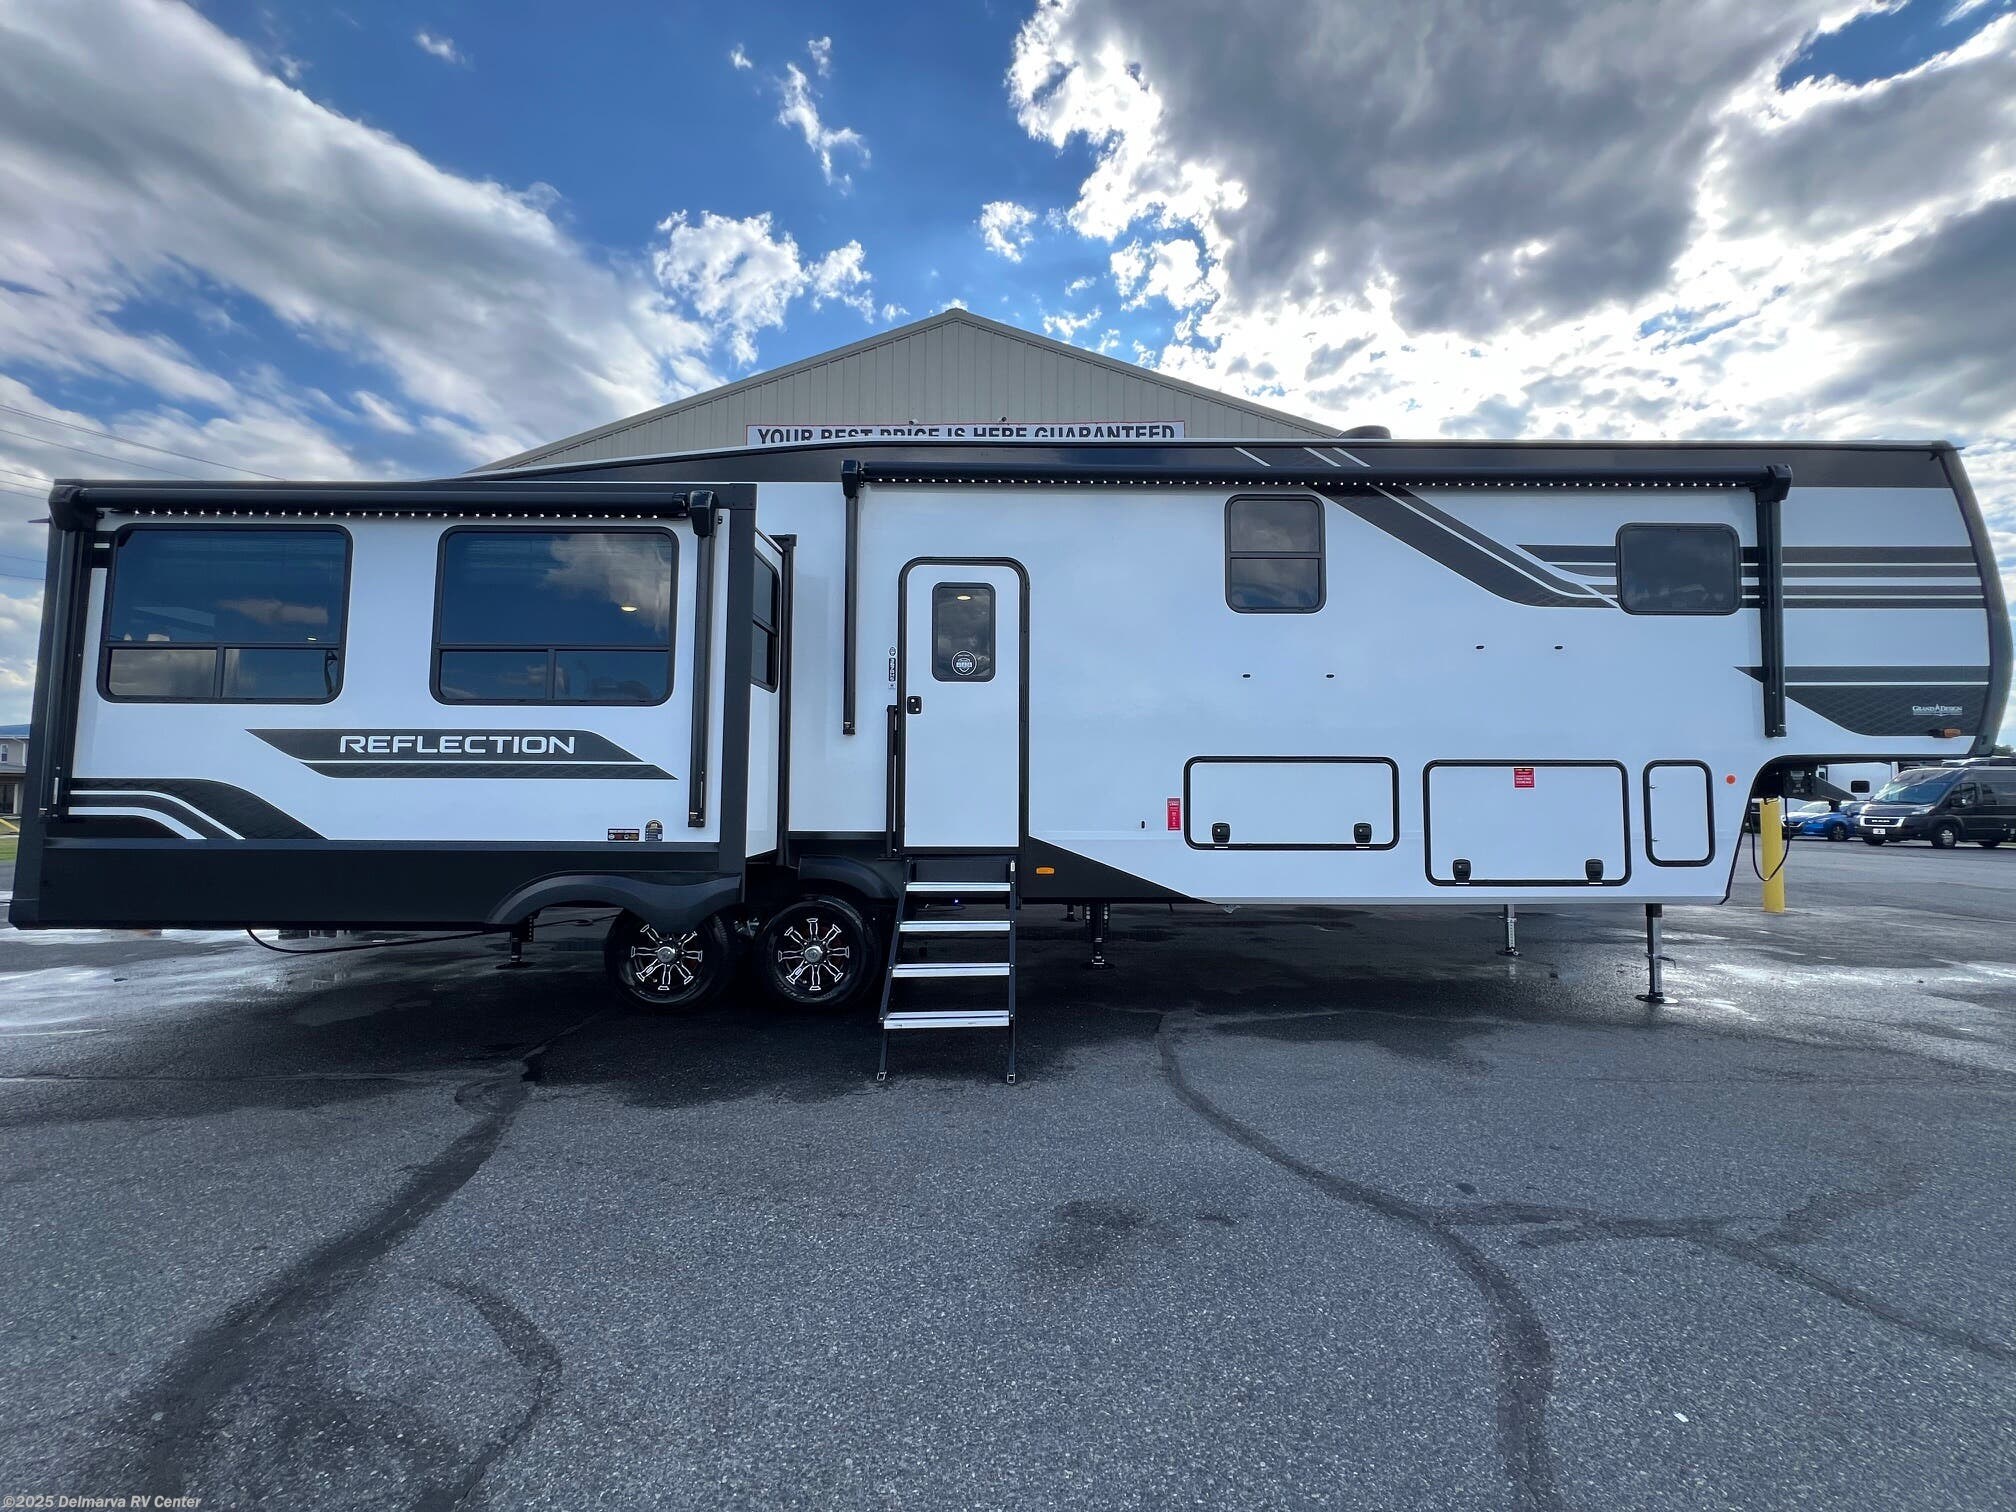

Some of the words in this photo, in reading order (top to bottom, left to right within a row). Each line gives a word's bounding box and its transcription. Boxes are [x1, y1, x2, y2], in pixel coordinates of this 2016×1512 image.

[757, 428, 813, 444] YOUR
[821, 428, 873, 440] BEST
[880, 427, 940, 438] PRICE
[947, 427, 966, 437] IS
[973, 427, 1027, 437] HERE
[1034, 425, 1175, 438] GUARANTEED
[339, 735, 576, 755] REFLECTION
